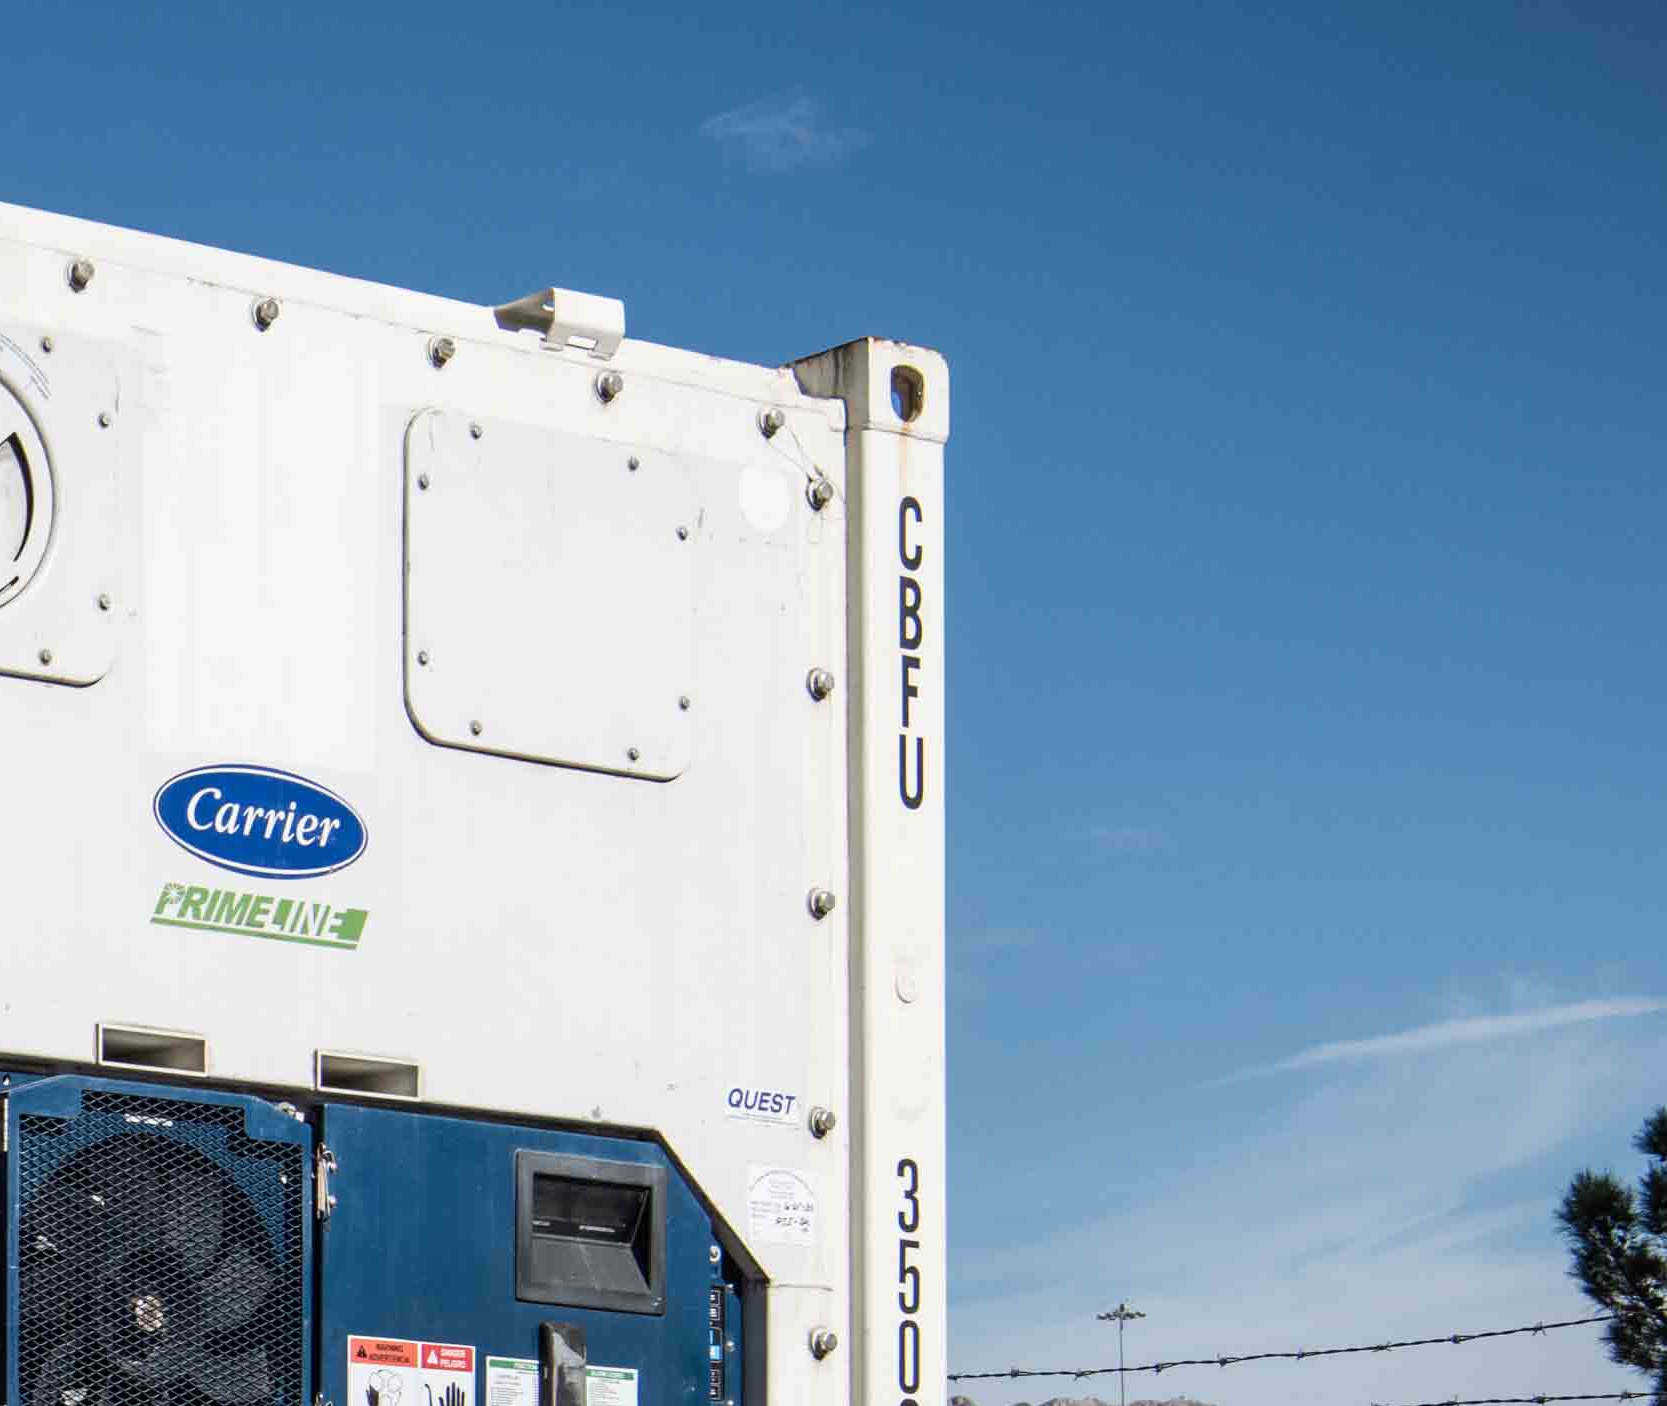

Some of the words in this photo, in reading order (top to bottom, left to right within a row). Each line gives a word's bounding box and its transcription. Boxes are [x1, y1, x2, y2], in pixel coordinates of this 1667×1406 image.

[899, 495, 923, 810] CBFU
[186, 787, 341, 848] Carrier
[154, 882, 368, 942] PRIMELINE
[728, 1087, 796, 1115] QUEST
